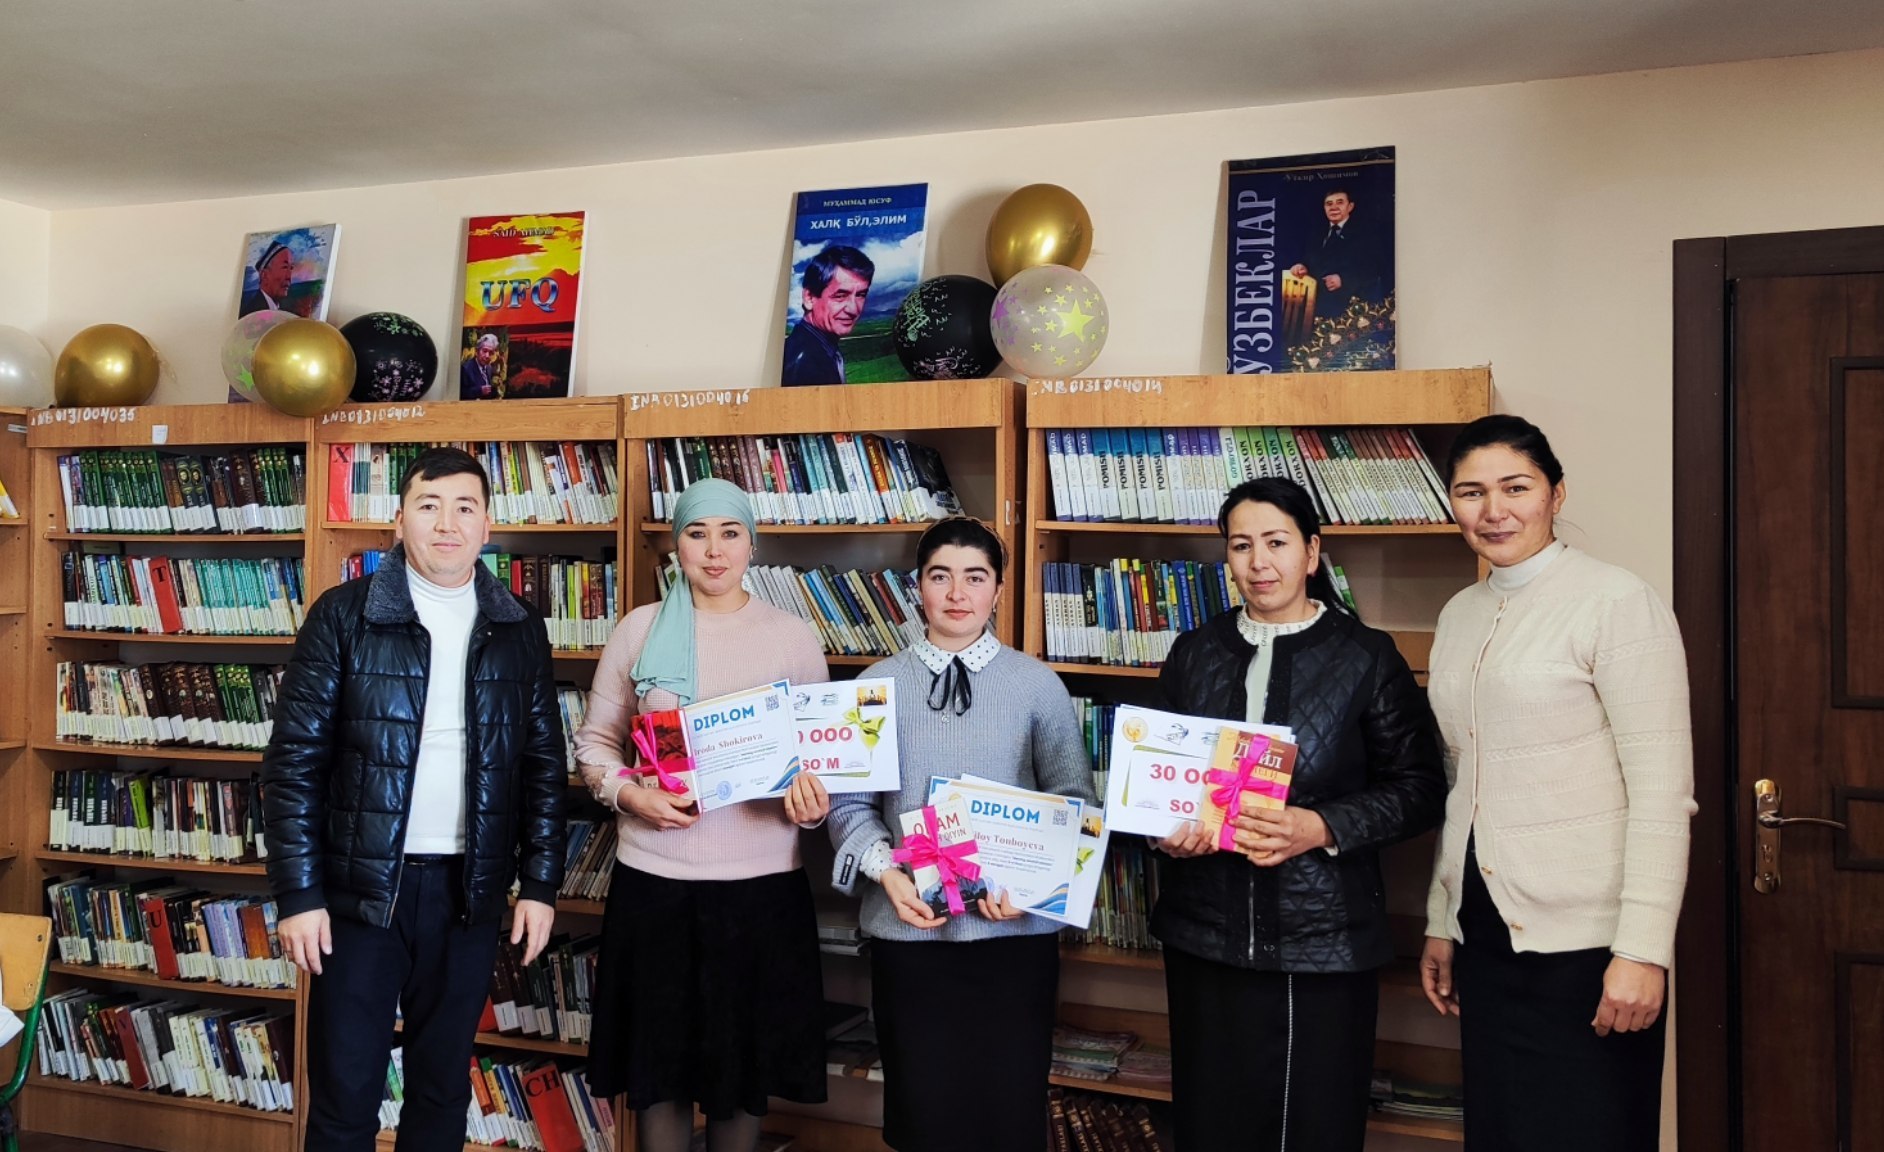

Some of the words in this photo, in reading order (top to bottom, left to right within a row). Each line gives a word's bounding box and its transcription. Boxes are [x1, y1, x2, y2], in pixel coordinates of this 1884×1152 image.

[810, 219, 841, 230] ХАЛҚ
[480, 277, 559, 313] UFQ
[152, 566, 167, 583] T
[693, 705, 755, 732] DIPLOM
[1232, 741, 1283, 769] Дйл
[1150, 763, 1176, 781] 30
[914, 812, 961, 835] OAM
[971, 799, 1040, 824] DIPLOM
[526, 1069, 560, 1098] CH
